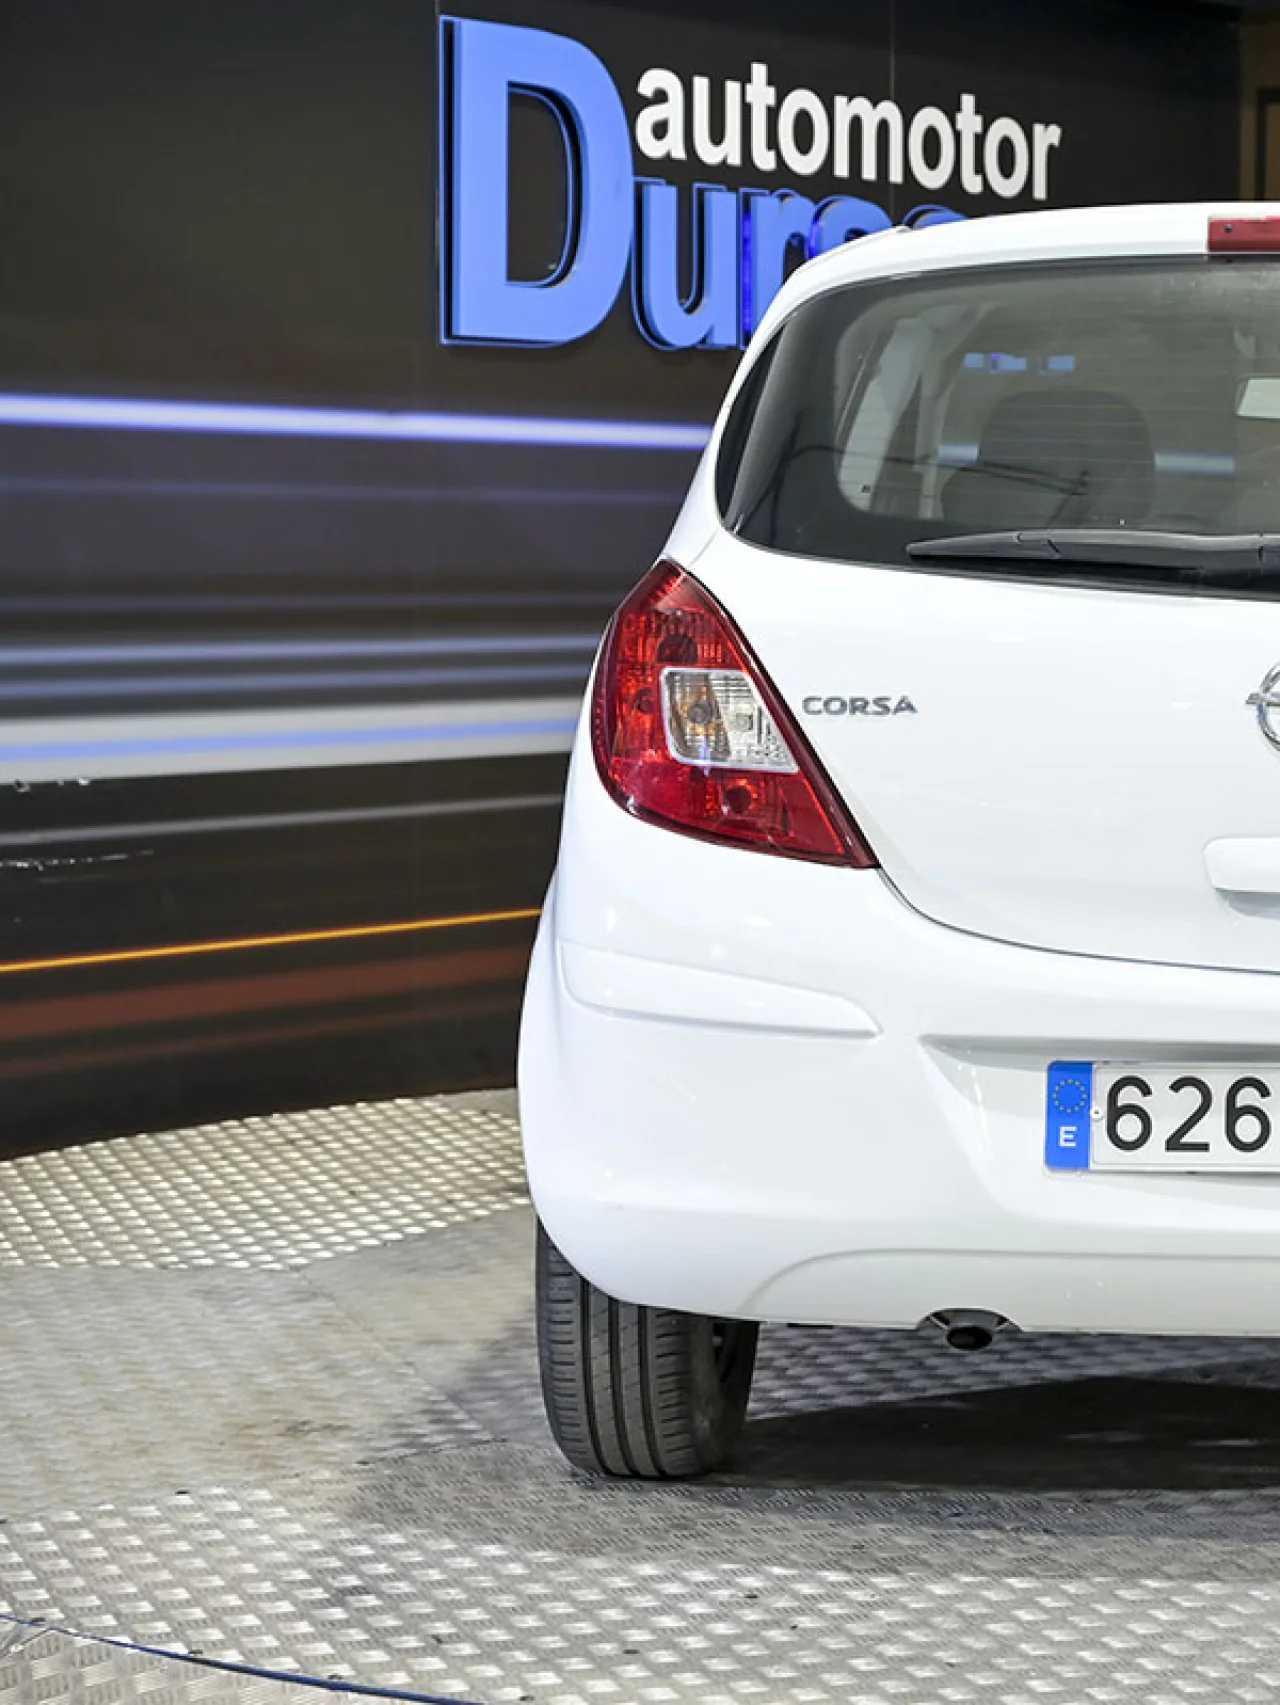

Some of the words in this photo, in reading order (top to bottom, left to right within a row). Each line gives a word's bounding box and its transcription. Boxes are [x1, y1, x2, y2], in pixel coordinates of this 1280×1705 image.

[635, 61, 1062, 201] automotor
[439, 14, 968, 351] Dur
[801, 695, 918, 716] CORSA
[1058, 1125, 1077, 1148] E
